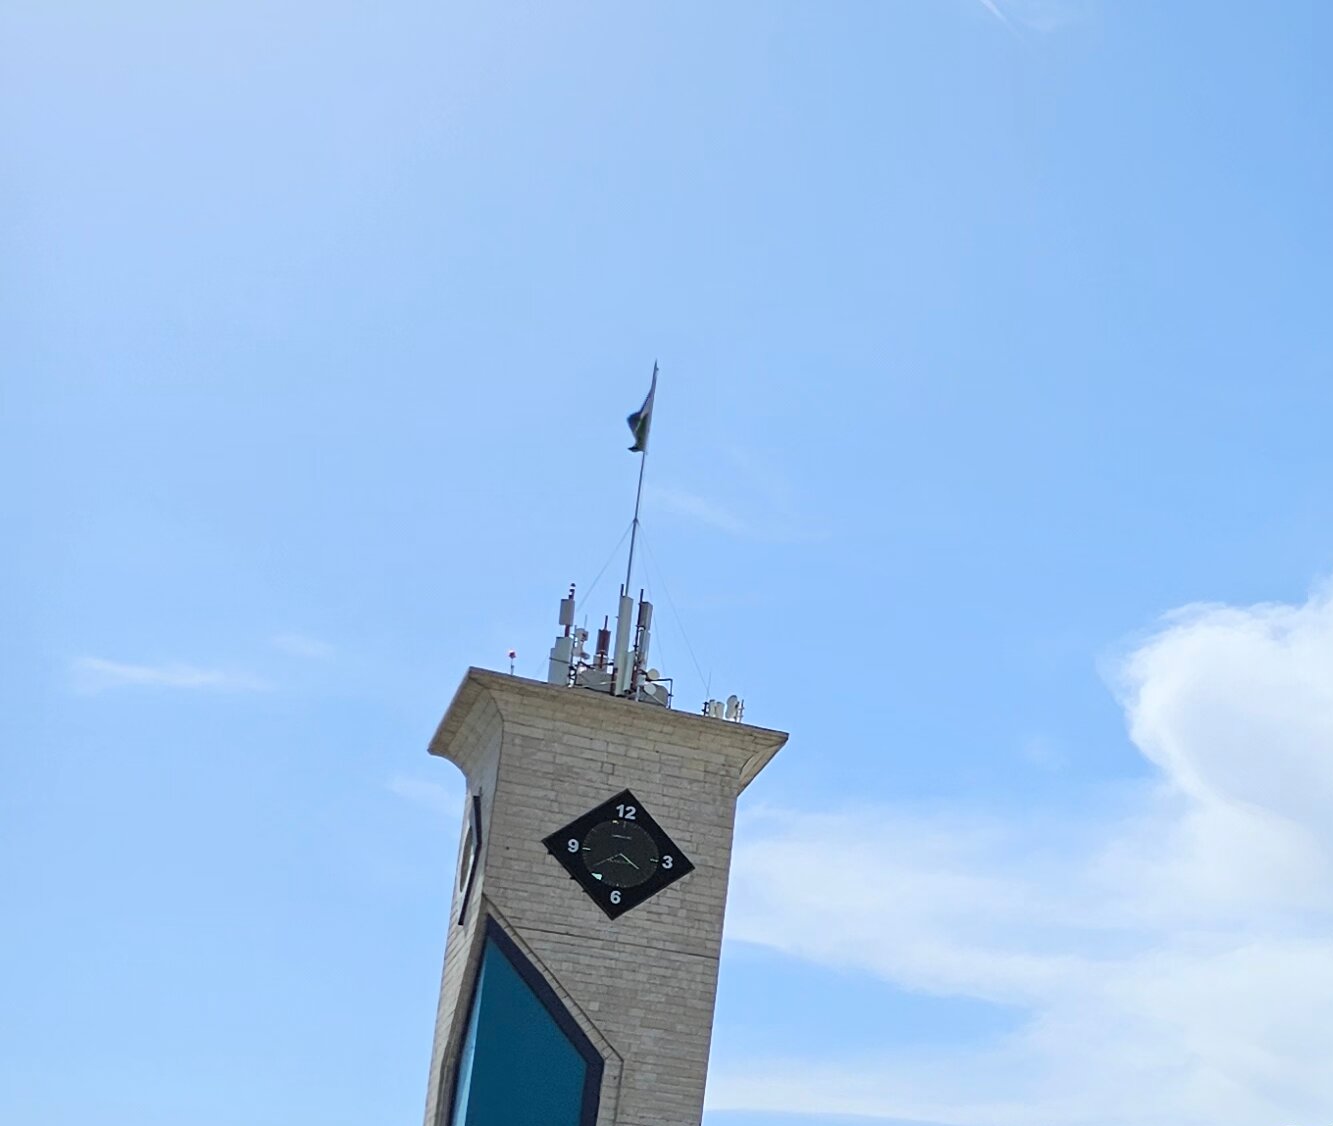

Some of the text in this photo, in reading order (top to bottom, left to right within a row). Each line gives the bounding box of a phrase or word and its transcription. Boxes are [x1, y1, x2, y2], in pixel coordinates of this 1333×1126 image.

[616, 804, 637, 820] 12
[567, 838, 580, 853] 9
[661, 855, 673, 869] 3
[610, 890, 621, 904] 6
